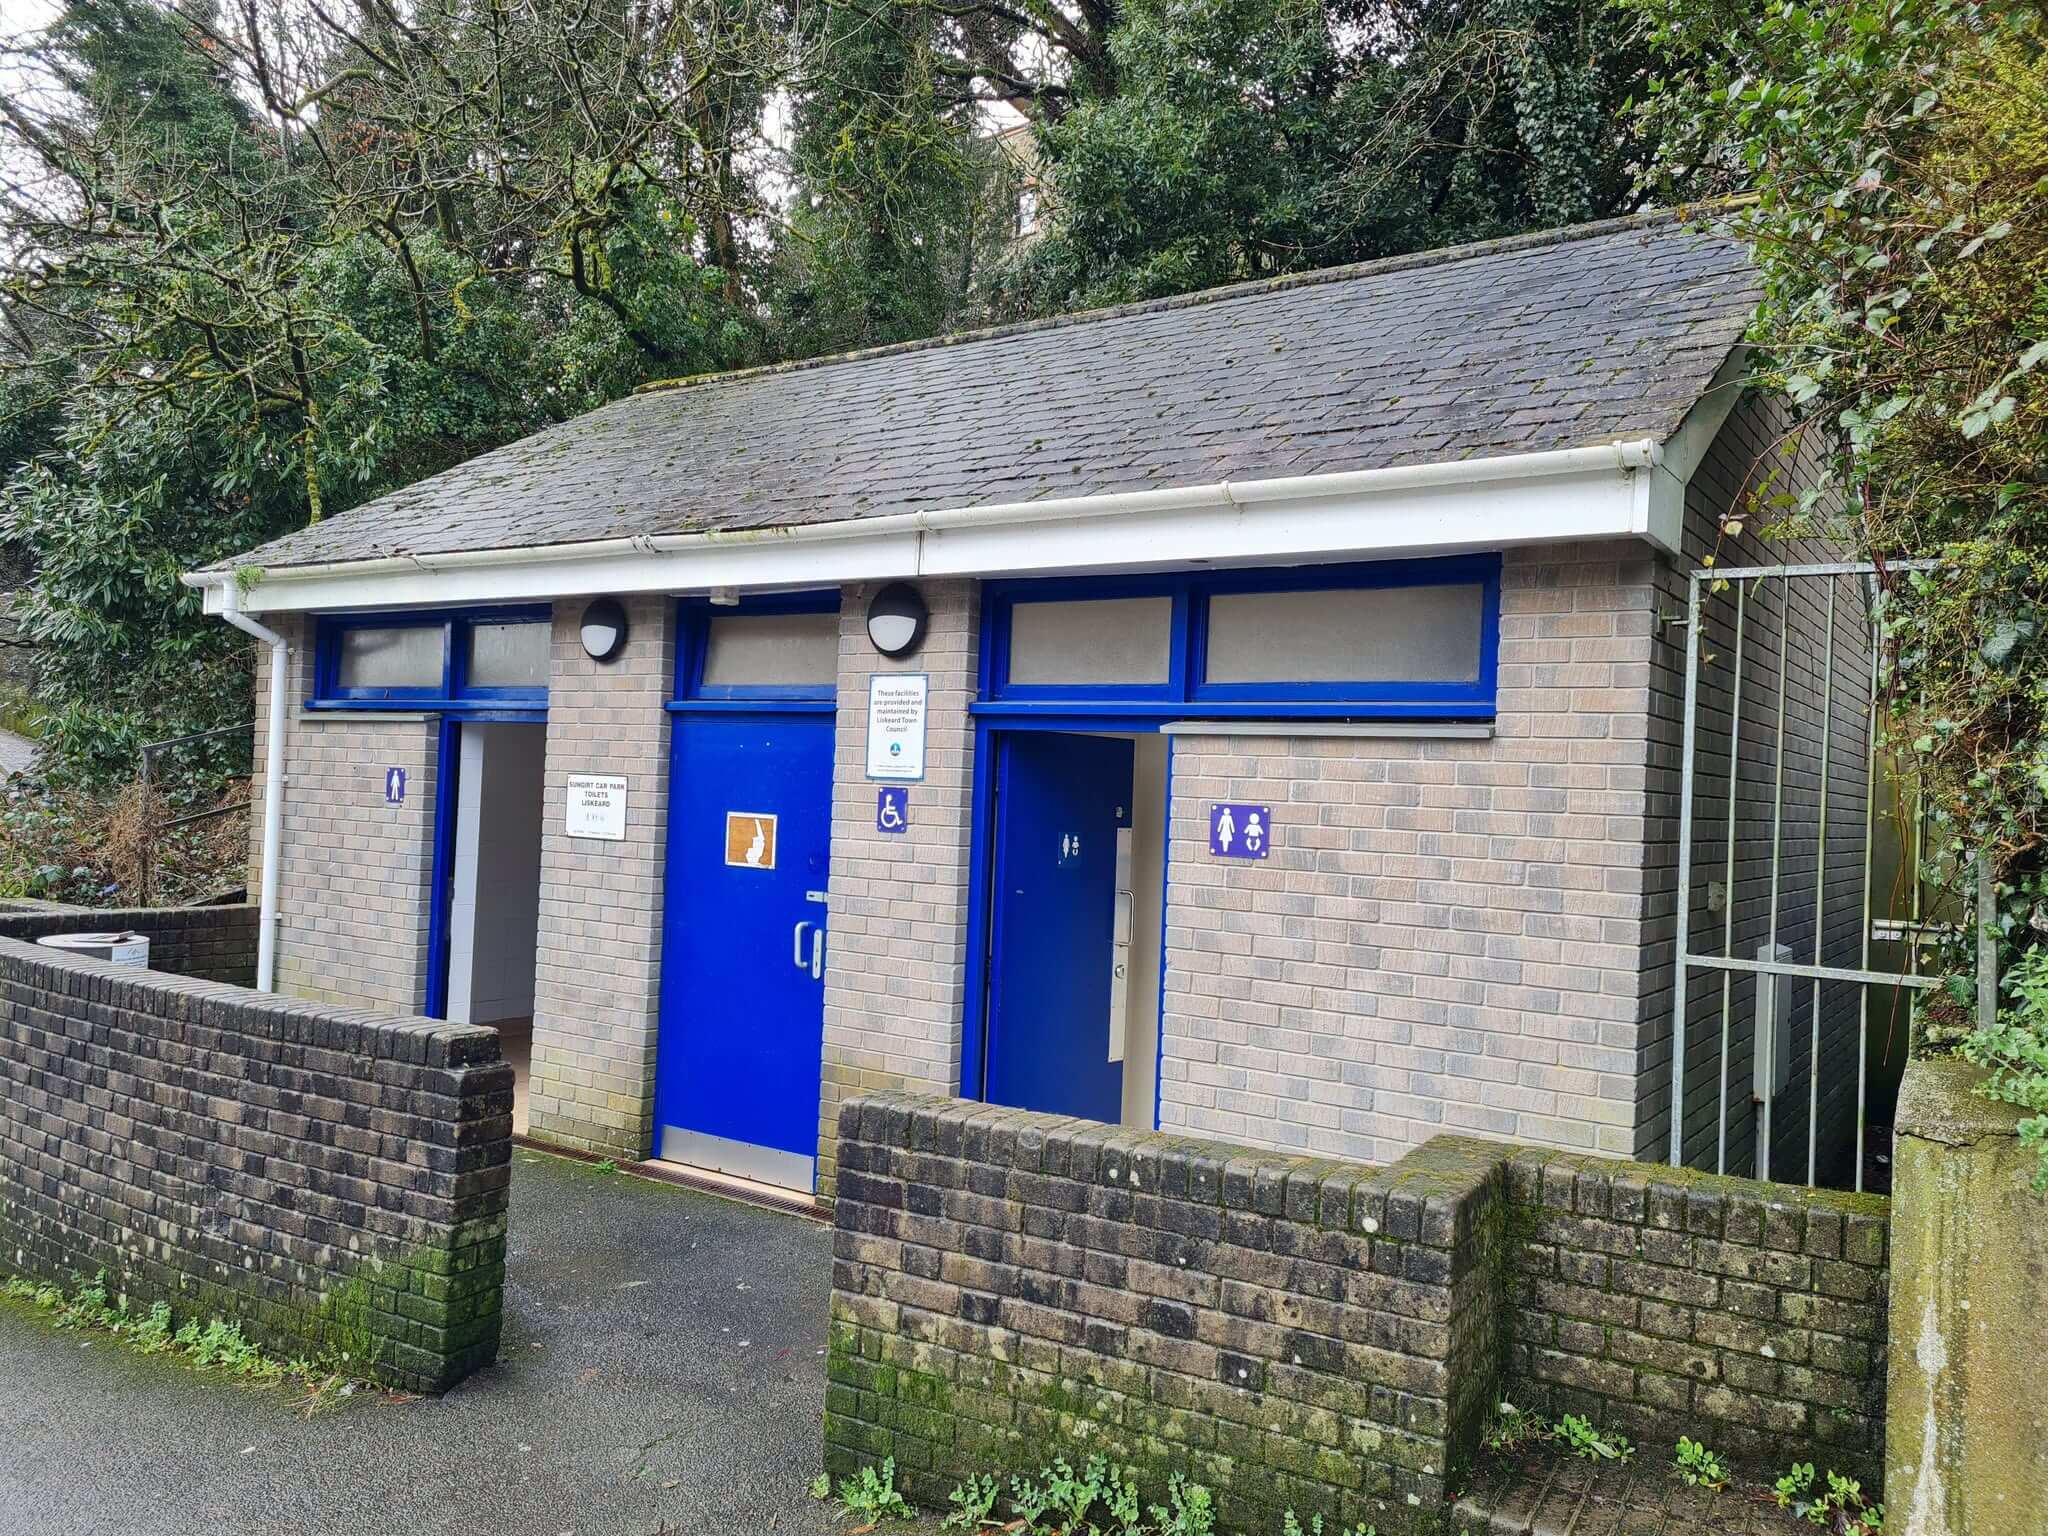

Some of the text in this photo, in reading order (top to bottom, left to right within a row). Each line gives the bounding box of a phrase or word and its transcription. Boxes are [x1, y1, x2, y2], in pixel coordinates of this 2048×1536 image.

[884, 699, 910, 707] provided
[595, 782, 608, 790] CAR
[609, 783, 625, 791] PARK
